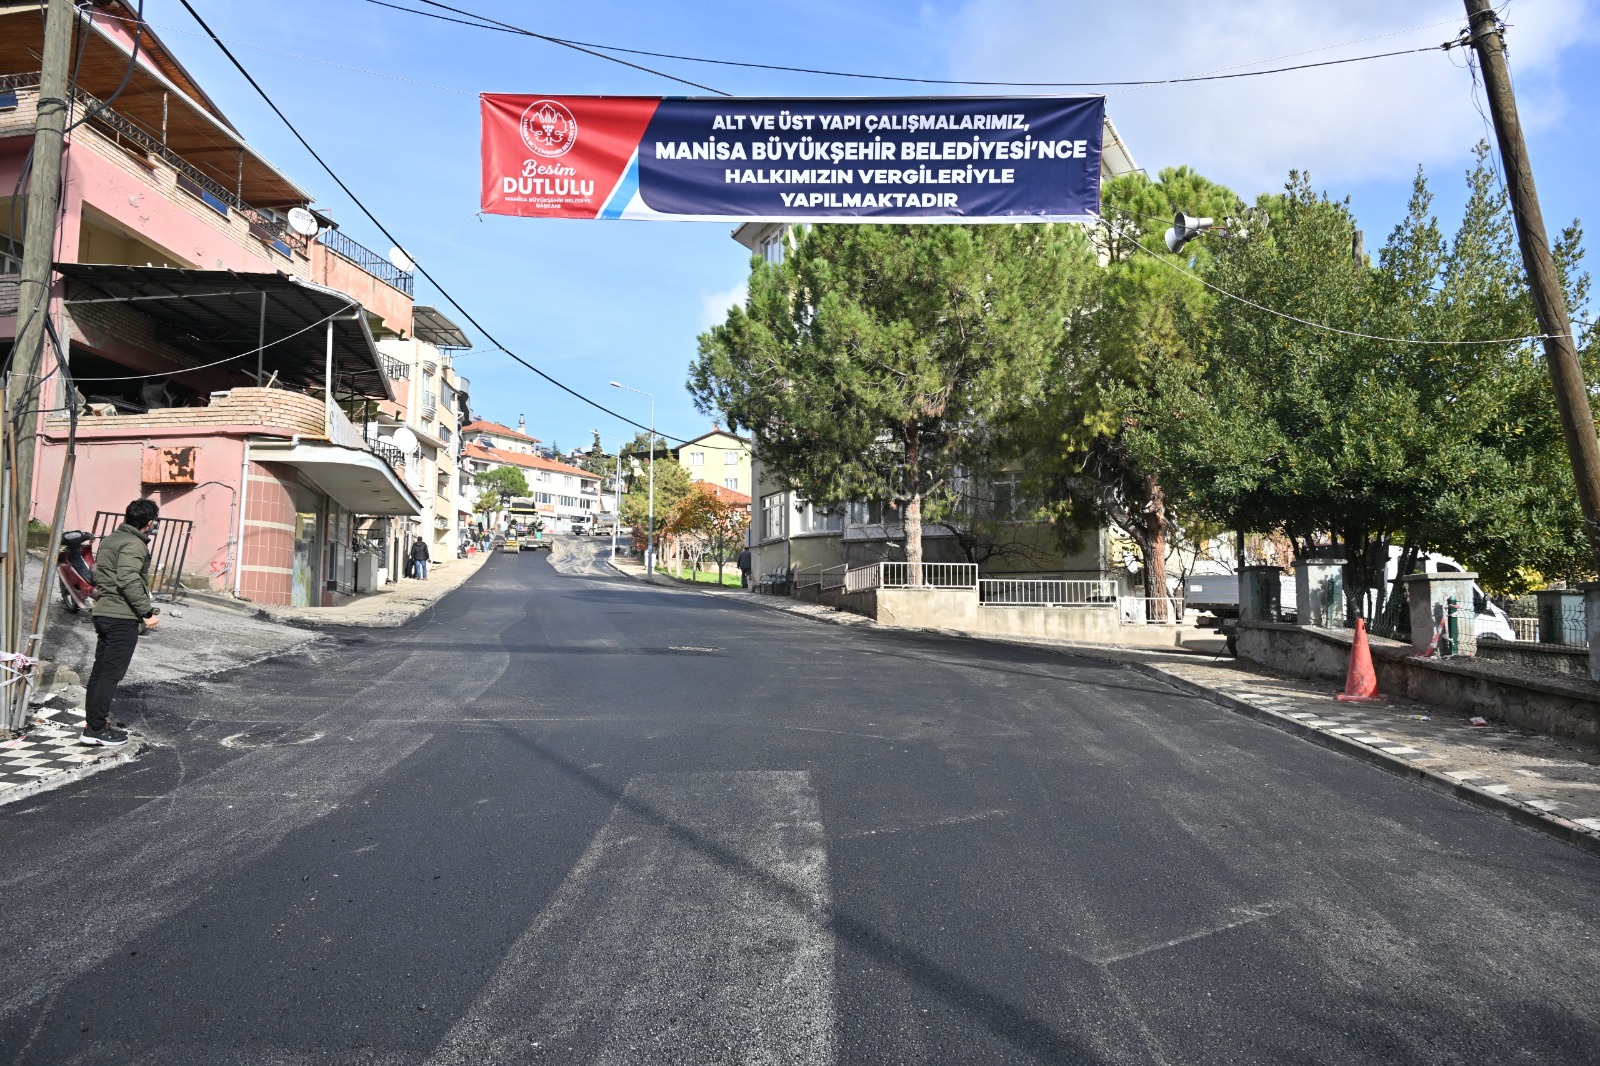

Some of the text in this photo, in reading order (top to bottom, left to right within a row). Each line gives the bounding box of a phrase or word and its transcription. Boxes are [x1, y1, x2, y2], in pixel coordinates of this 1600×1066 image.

[713, 110, 1030, 134] ALT VE ÜST YAPI ÇALIŞMALARIMIZ,
[655, 135, 1088, 164] MANİSA BÜYÜKŞEHİR BELEDİYESİ'NCE
[521, 159, 577, 178] Besim
[725, 165, 1015, 184] HALKIMIZIN VERGİLERİYLE
[503, 176, 594, 196] DUTLULU
[780, 192, 958, 208] YAPILMAKTADIR
